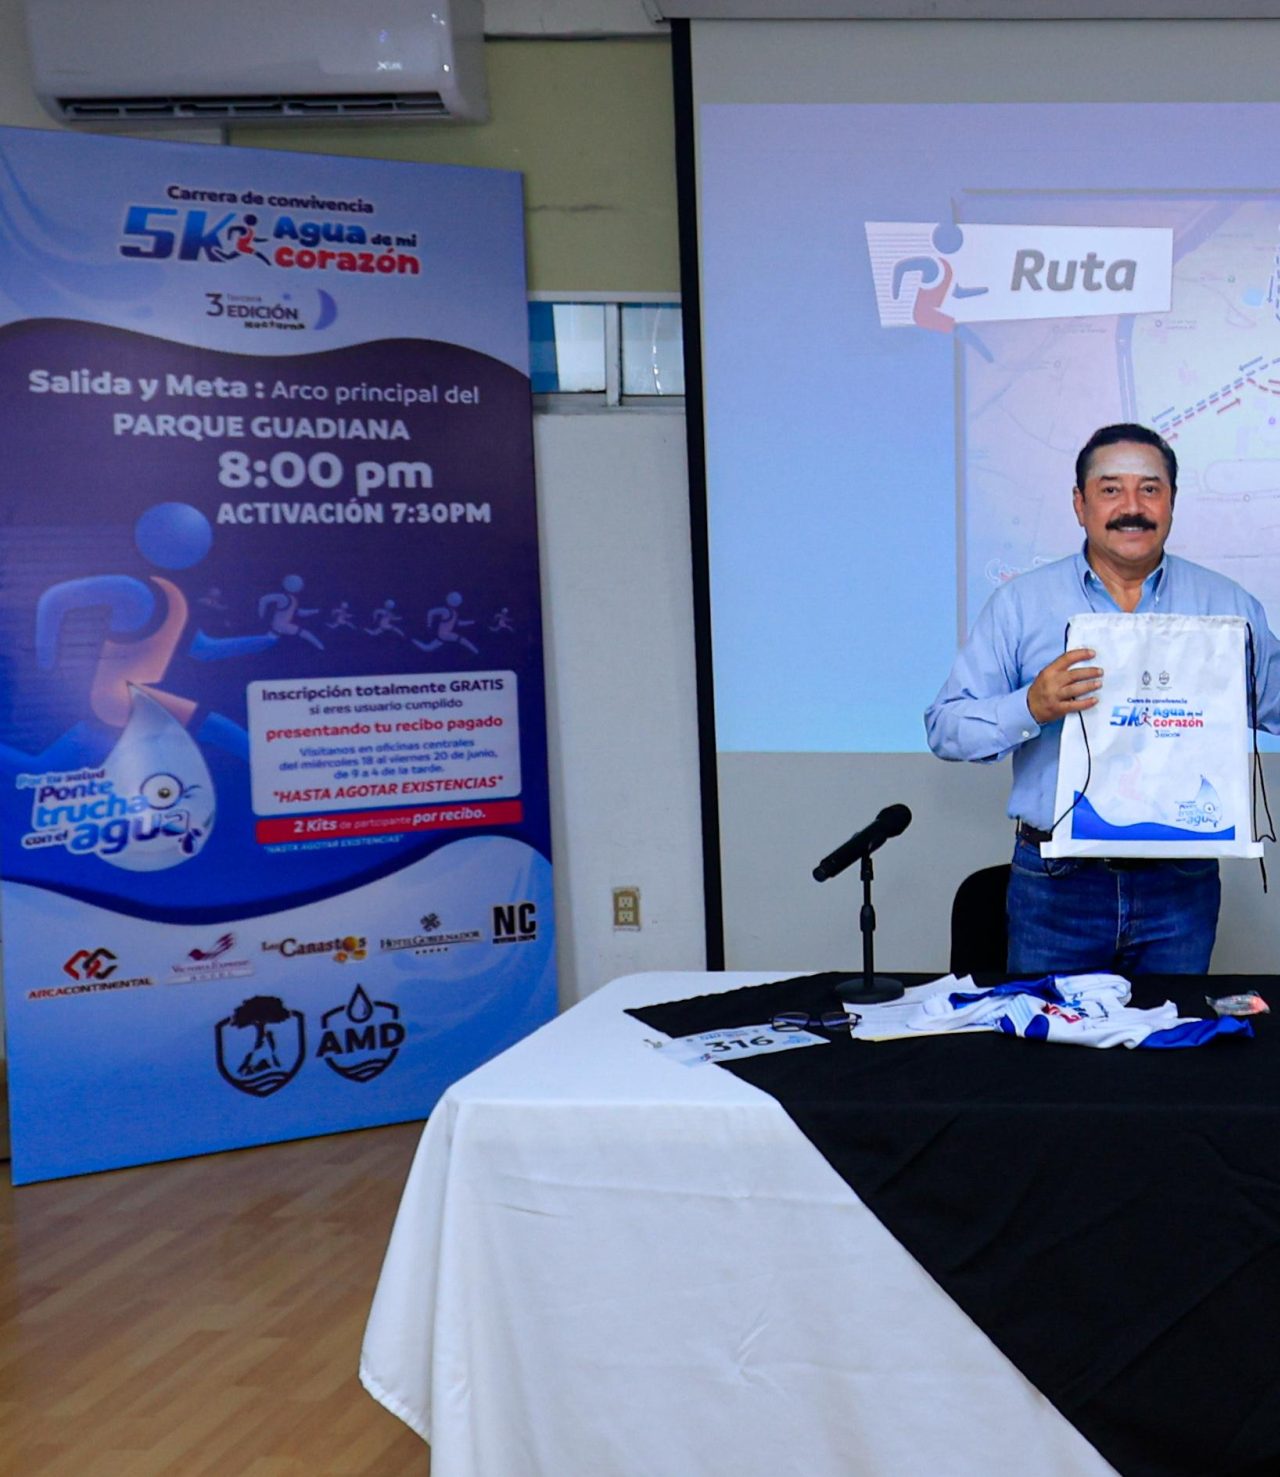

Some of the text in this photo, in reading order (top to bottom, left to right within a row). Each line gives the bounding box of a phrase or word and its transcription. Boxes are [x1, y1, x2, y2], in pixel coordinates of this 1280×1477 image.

[167, 185, 374, 213] Carrera de convivencia
[120, 205, 238, 263] 5K
[273, 216, 417, 248] Agua de mi
[274, 247, 420, 275] corazón
[1010, 247, 1137, 292] Ruta
[205, 292, 223, 316] 3
[227, 303, 298, 320] EDICIÓN
[28, 369, 131, 395] Salida
[138, 377, 158, 400] y
[166, 373, 248, 398] Meta
[271, 381, 328, 401] Arco
[335, 382, 439, 408] principal
[445, 385, 480, 404] del
[113, 413, 411, 442] PARQUE GUADIANA
[217, 450, 433, 496] 8:00 pm
[216, 497, 491, 525] ACTIVACIÓN 7:30PM
[262, 679, 504, 702] Inscripción totalmente GRATIS
[309, 698, 463, 715] si eres usuario cumplido
[1153, 707, 1185, 718] Agua
[266, 715, 503, 742] presentando tu recibo pagado
[1153, 717, 1204, 727] corazón
[359, 745, 372, 754] en
[375, 741, 419, 753] oficinas
[423, 738, 474, 751] centrales
[279, 760, 298, 771] del
[376, 755, 386, 765] al
[389, 753, 431, 764] viernes
[433, 751, 448, 761] 20
[451, 750, 464, 760] de
[334, 770, 349, 780] de
[381, 766, 396, 776] de
[398, 765, 409, 775] la
[38, 781, 114, 803] Ponte
[335, 784, 397, 799] AGOTAR
[37, 794, 150, 827] trucha
[294, 821, 304, 833] 2
[307, 818, 336, 831] Kits
[412, 812, 436, 825] por
[70, 810, 189, 854] agua
[493, 902, 537, 937] NC
[28, 978, 153, 1000] ARCACONTINENTAL
[316, 1022, 406, 1057] AMD
[705, 1036, 774, 1053] 316
